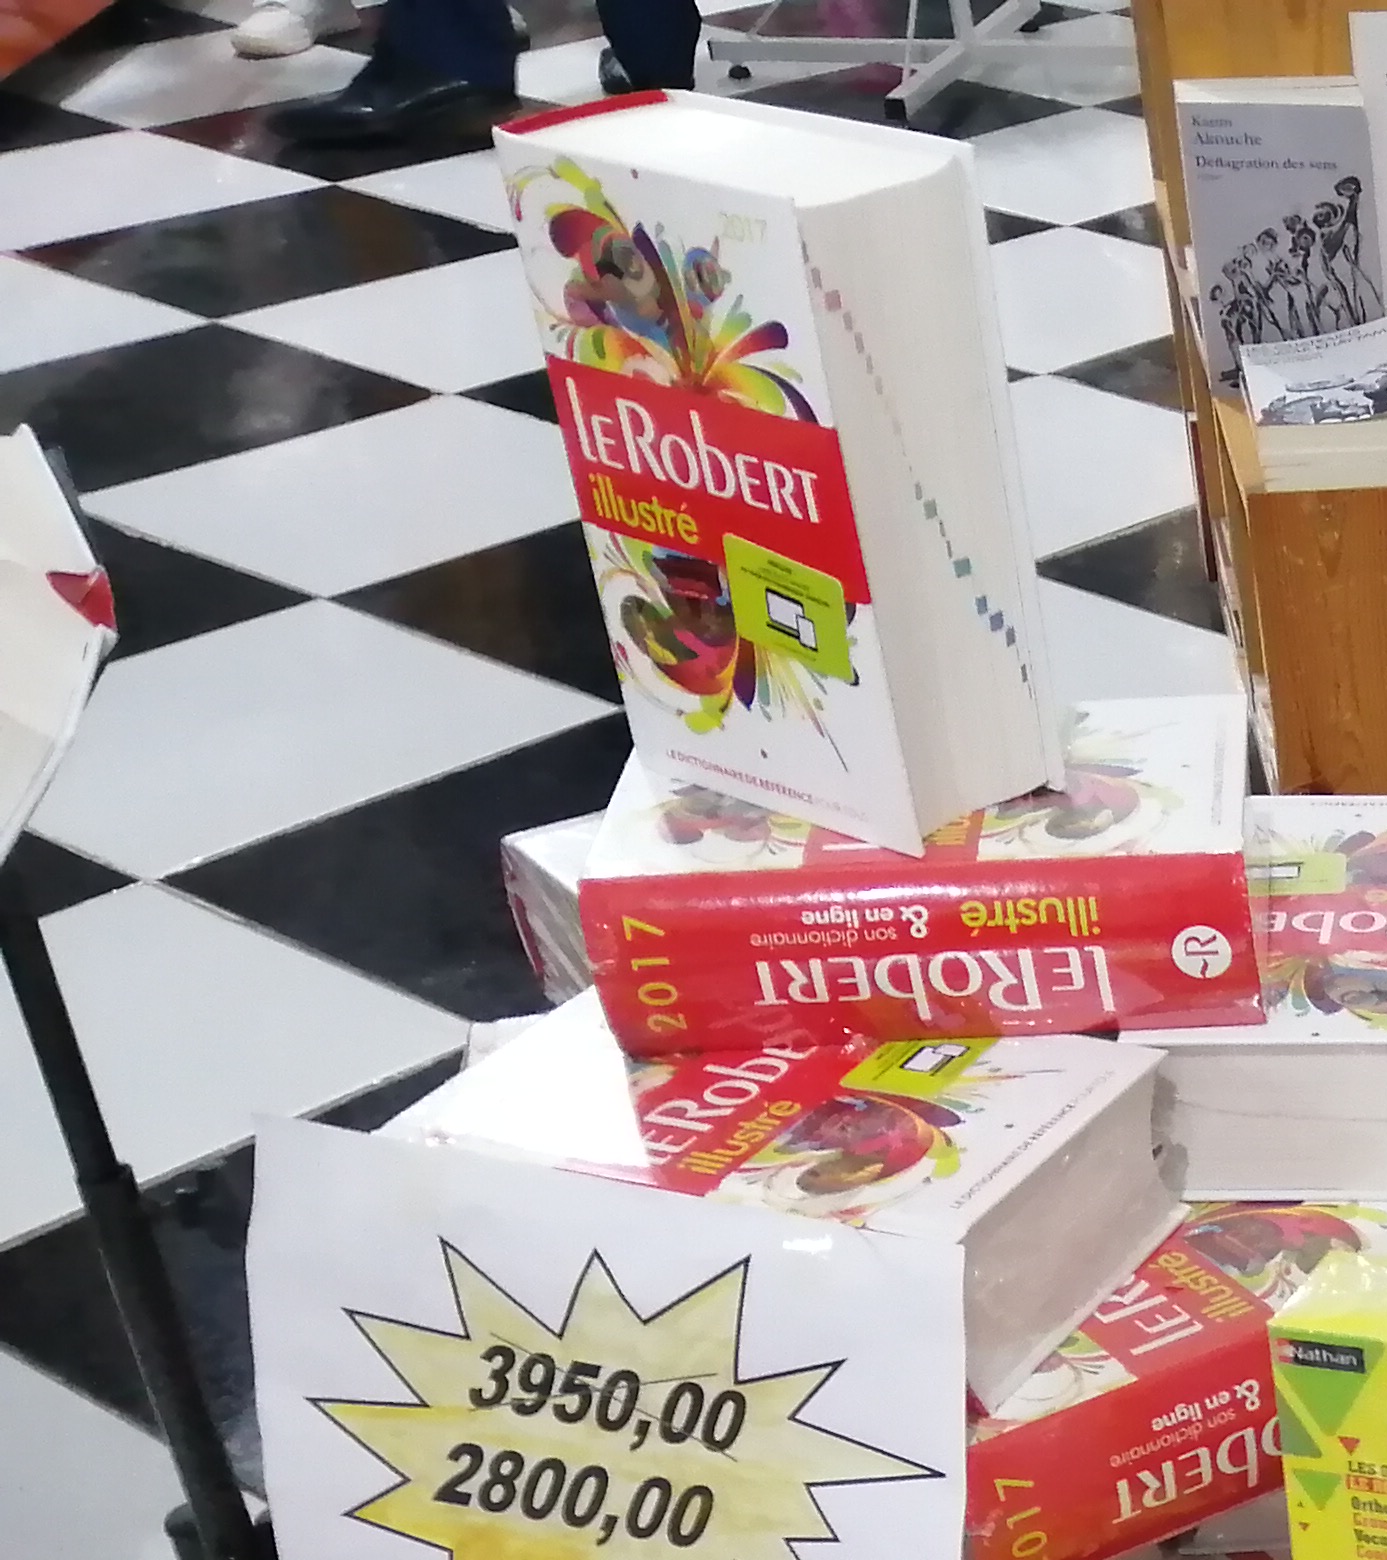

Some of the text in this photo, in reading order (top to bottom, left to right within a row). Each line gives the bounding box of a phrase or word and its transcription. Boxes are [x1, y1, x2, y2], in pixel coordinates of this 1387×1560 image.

[1283, 158, 1306, 170] des
[592, 474, 699, 545] illustré
[750, 929, 899, 948] son dictionnaire
[800, 907, 929, 938] & en ligne
[960, 898, 1101, 936] illustré
[621, 916, 687, 1033] 2017
[677, 1098, 801, 1177] illustré
[1157, 1250, 1256, 1322] illustré
[1287, 1345, 1359, 1367] Nathan
[469, 1345, 748, 1453] 3950,00
[434, 1443, 714, 1548] 2800,00
[1348, 1461, 1377, 1476] LES
